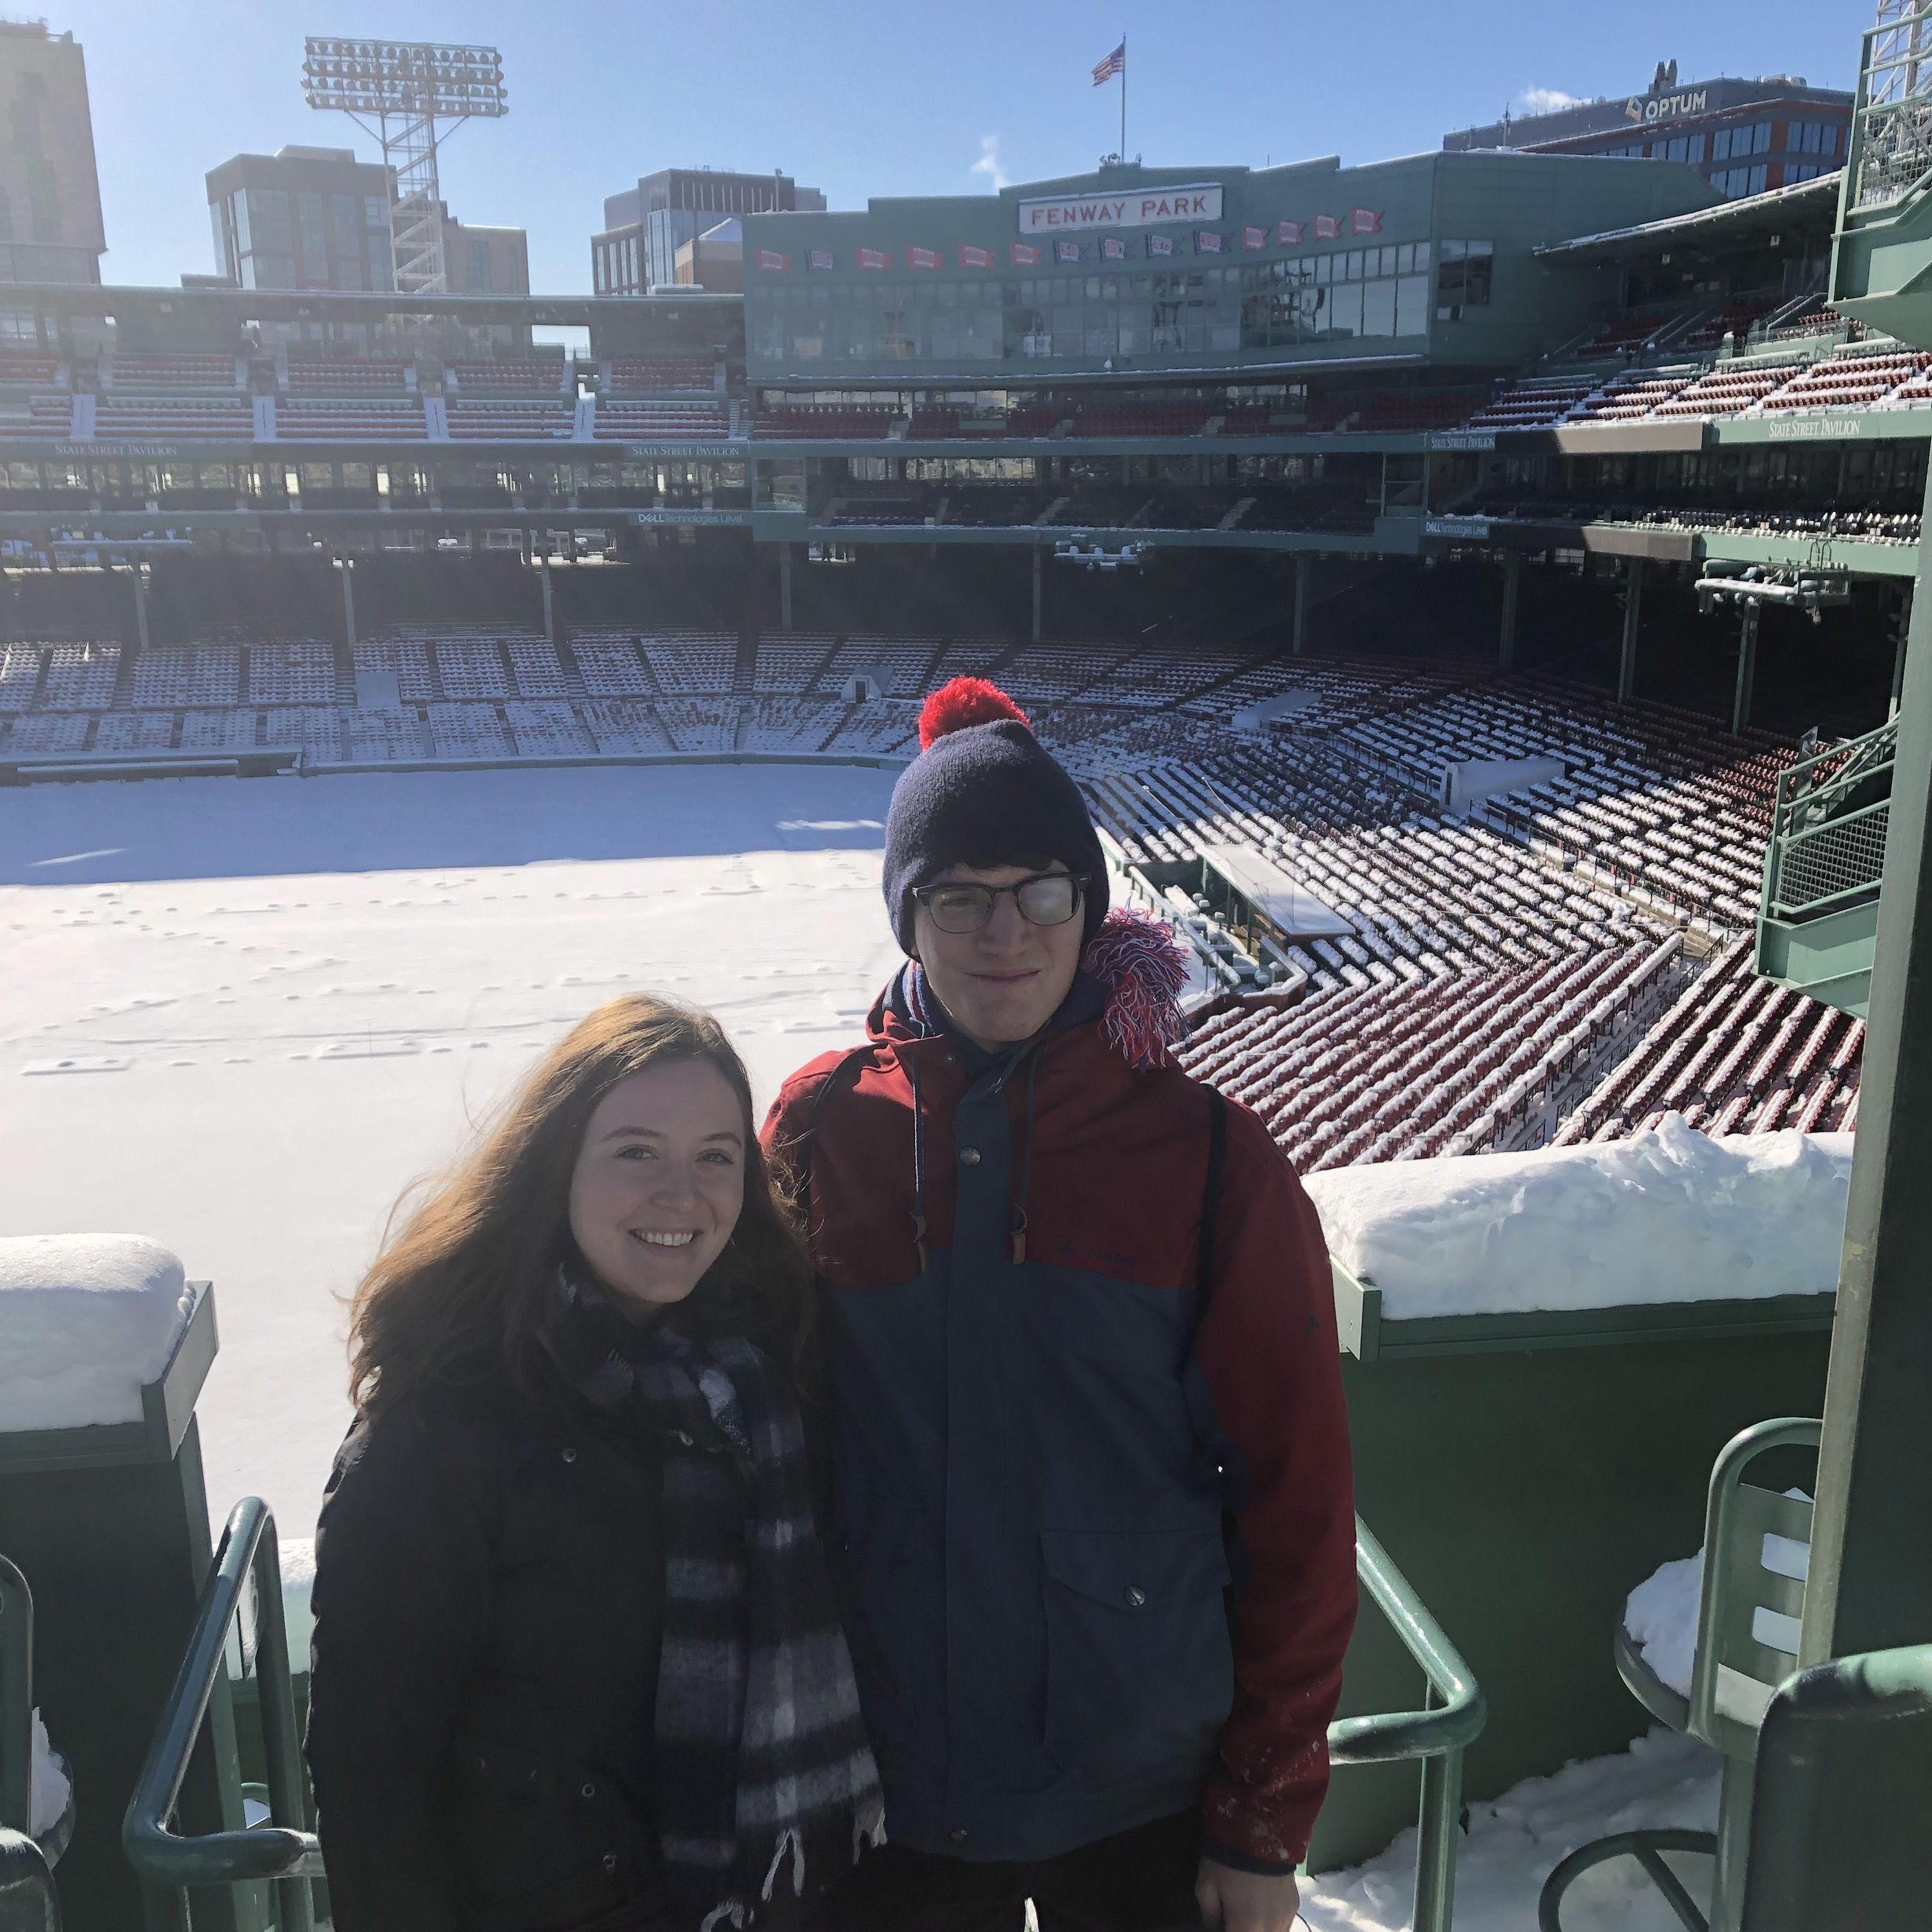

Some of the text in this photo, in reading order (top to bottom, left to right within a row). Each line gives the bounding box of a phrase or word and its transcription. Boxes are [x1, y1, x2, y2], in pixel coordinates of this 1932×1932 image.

[1645, 90, 1706, 119] OPTUM
[1031, 195, 1206, 226] FENWAY PARK
[1821, 418, 1862, 436] PAVILION
[696, 445, 740, 456] PAVILION
[638, 514, 742, 525] DELL Technologies Level
